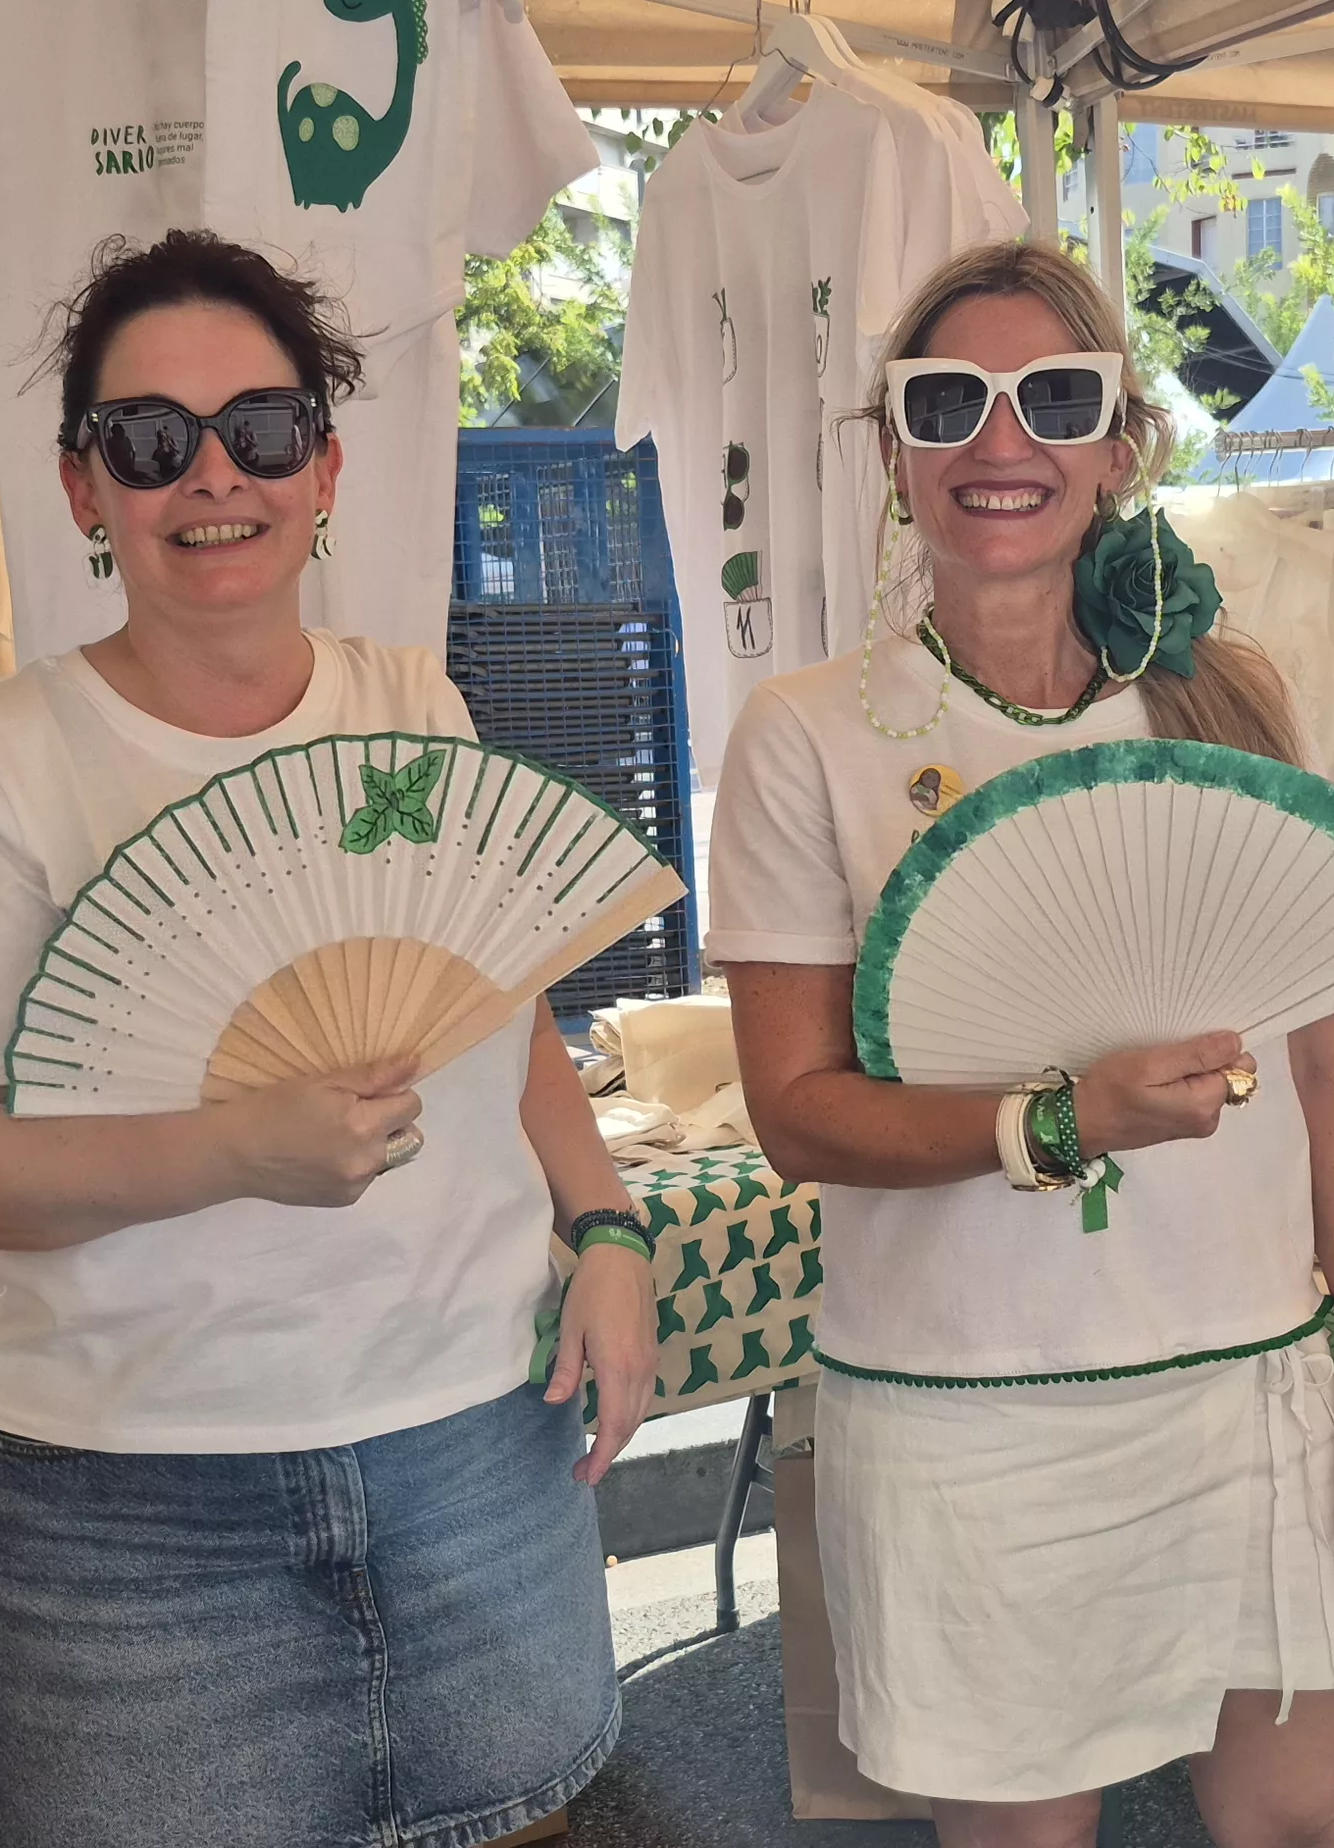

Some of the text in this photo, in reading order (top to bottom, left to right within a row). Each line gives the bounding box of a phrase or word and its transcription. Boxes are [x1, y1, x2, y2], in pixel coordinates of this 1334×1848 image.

[90, 125, 147, 147] DIVER
[177, 144, 194, 152] mal
[94, 145, 155, 176] SARIO
